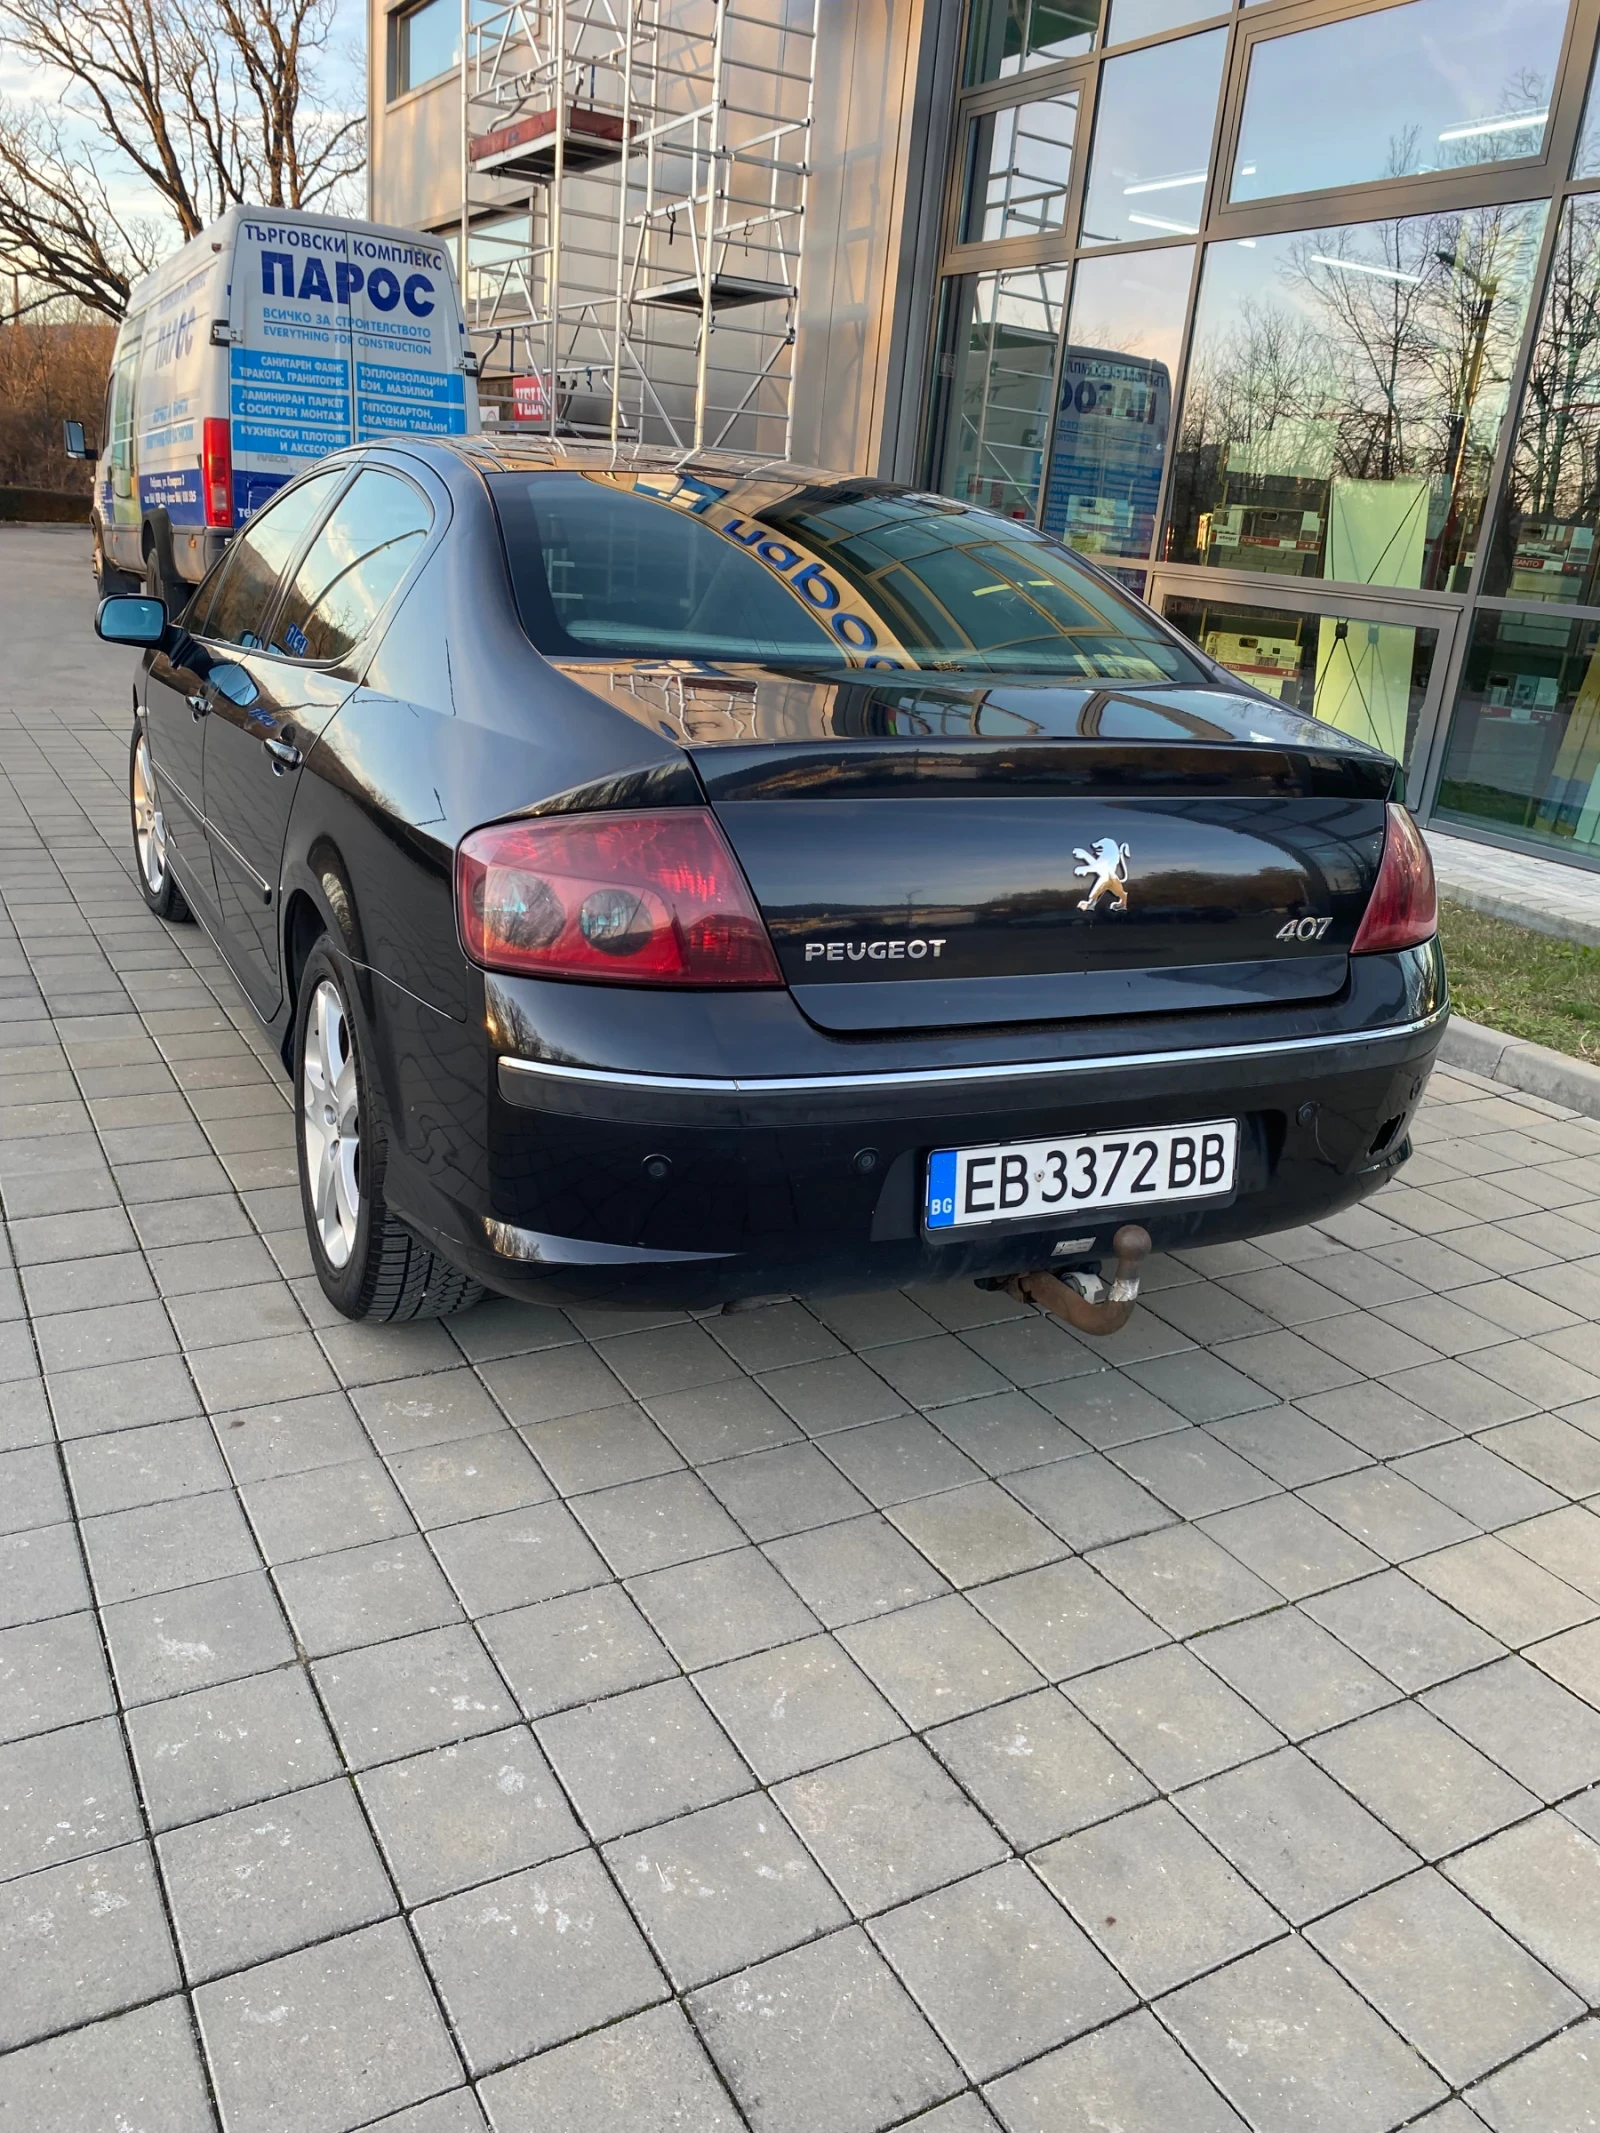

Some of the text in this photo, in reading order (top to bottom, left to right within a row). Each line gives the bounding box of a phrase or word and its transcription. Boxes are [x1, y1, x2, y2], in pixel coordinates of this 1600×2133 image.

[245, 224, 442, 270] ТЪРГОВСКИ КОМПЛЕКС
[261, 250, 435, 318] ПАРОС
[263, 307, 431, 338] ВСИЧКО ЗА СТРОИТЕЛСТВОТО
[264, 325, 330, 342] EVERYTHING
[358, 335, 431, 355] CONSTRUCTION
[261, 356, 311, 370] САНИТАРЕН
[360, 366, 448, 387] ТОПЛОИЗОЛАЦИИ
[242, 389, 344, 408] ЛАМИНИРАН ПАРКЕТ
[386, 384, 434, 398] МАЗИЛКИ
[246, 404, 298, 417] ОСИГУРЕН
[301, 409, 345, 422] МОНТАЖ
[240, 425, 346, 444] КУХНЕНСКИ ПЛОТОВЕ
[410, 420, 448, 433] ТАВАНИ
[280, 442, 288, 452] И
[1275, 916, 1334, 942] 407
[805, 939, 947, 962] PEUGEOT
[963, 1133, 1225, 1214] EB 3372 BB
[930, 1197, 952, 1215] BG
